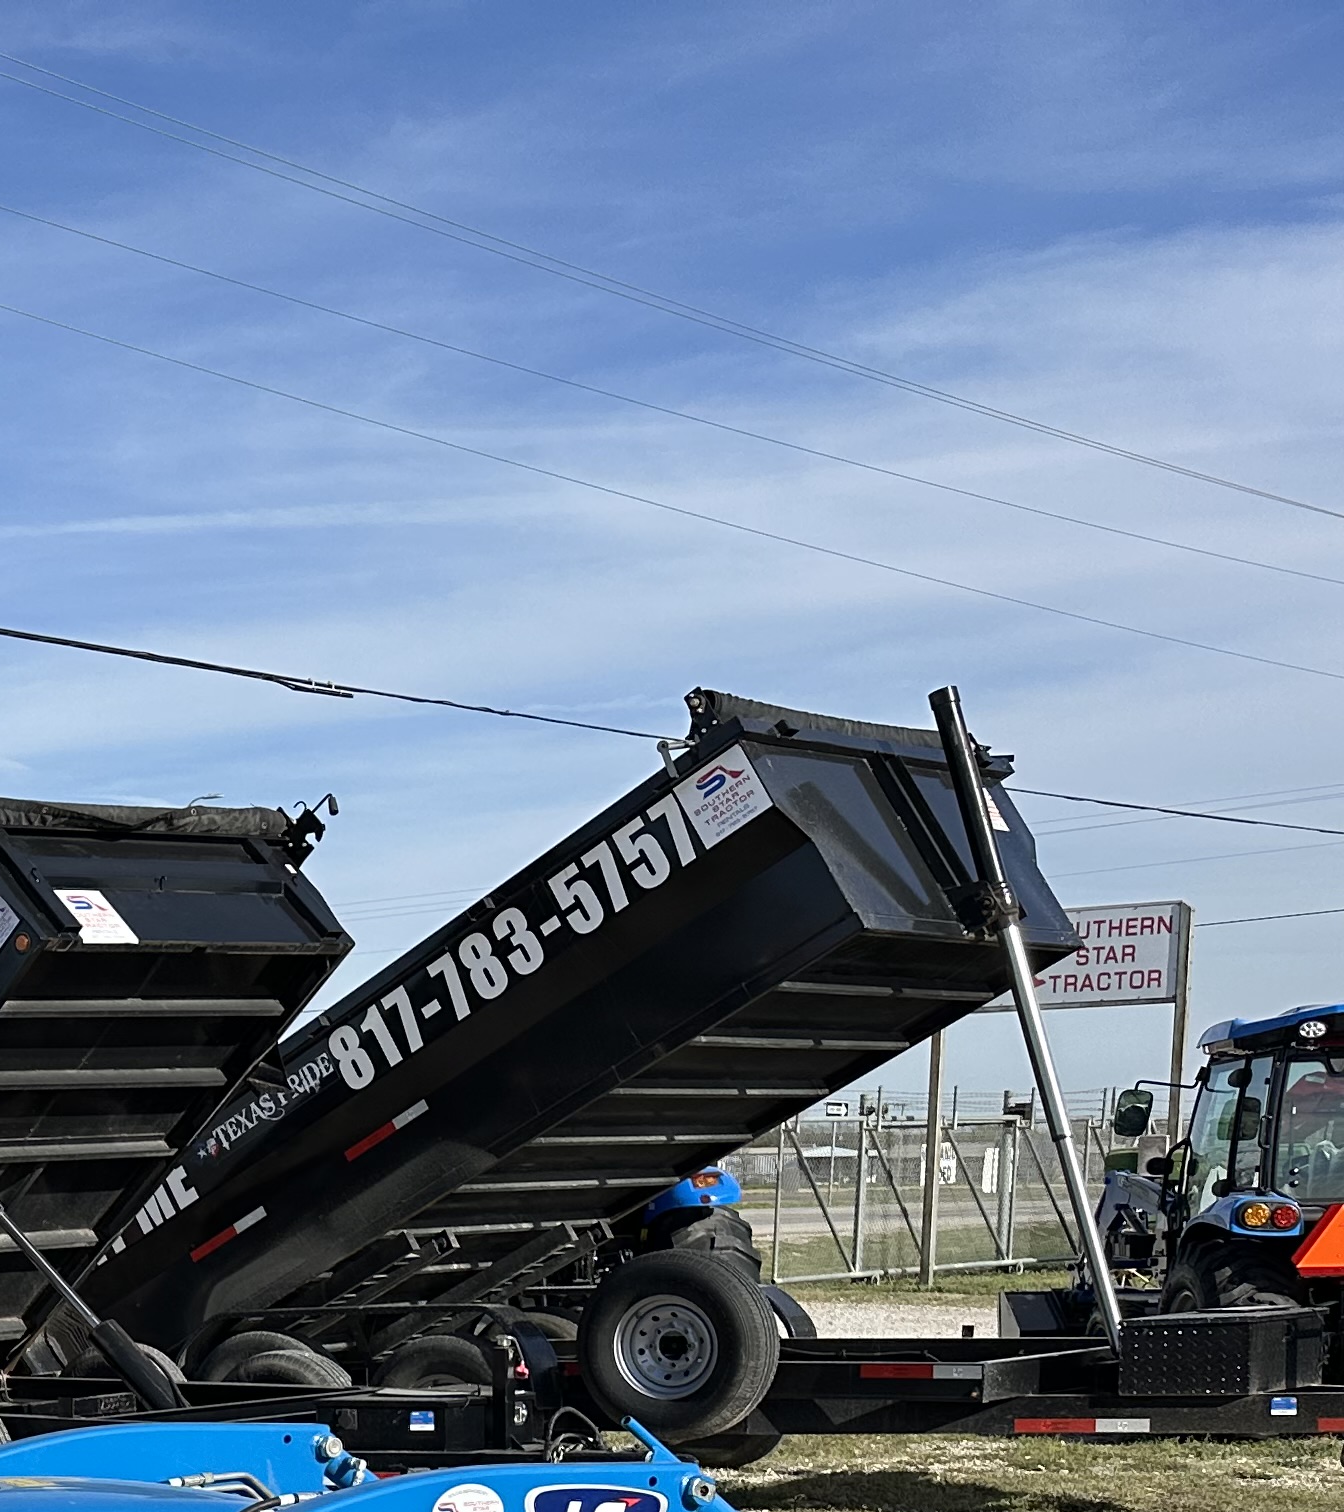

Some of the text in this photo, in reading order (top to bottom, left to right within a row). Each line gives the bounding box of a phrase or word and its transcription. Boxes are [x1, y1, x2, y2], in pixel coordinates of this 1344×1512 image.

[712, 791, 740, 813] STAR
[1075, 914, 1173, 940] UTHERN
[328, 792, 697, 1091] 817-783-5757
[1075, 944, 1137, 966] STAR
[1049, 969, 1162, 993] TRACTOR
[212, 1092, 285, 1151] TEXAS
